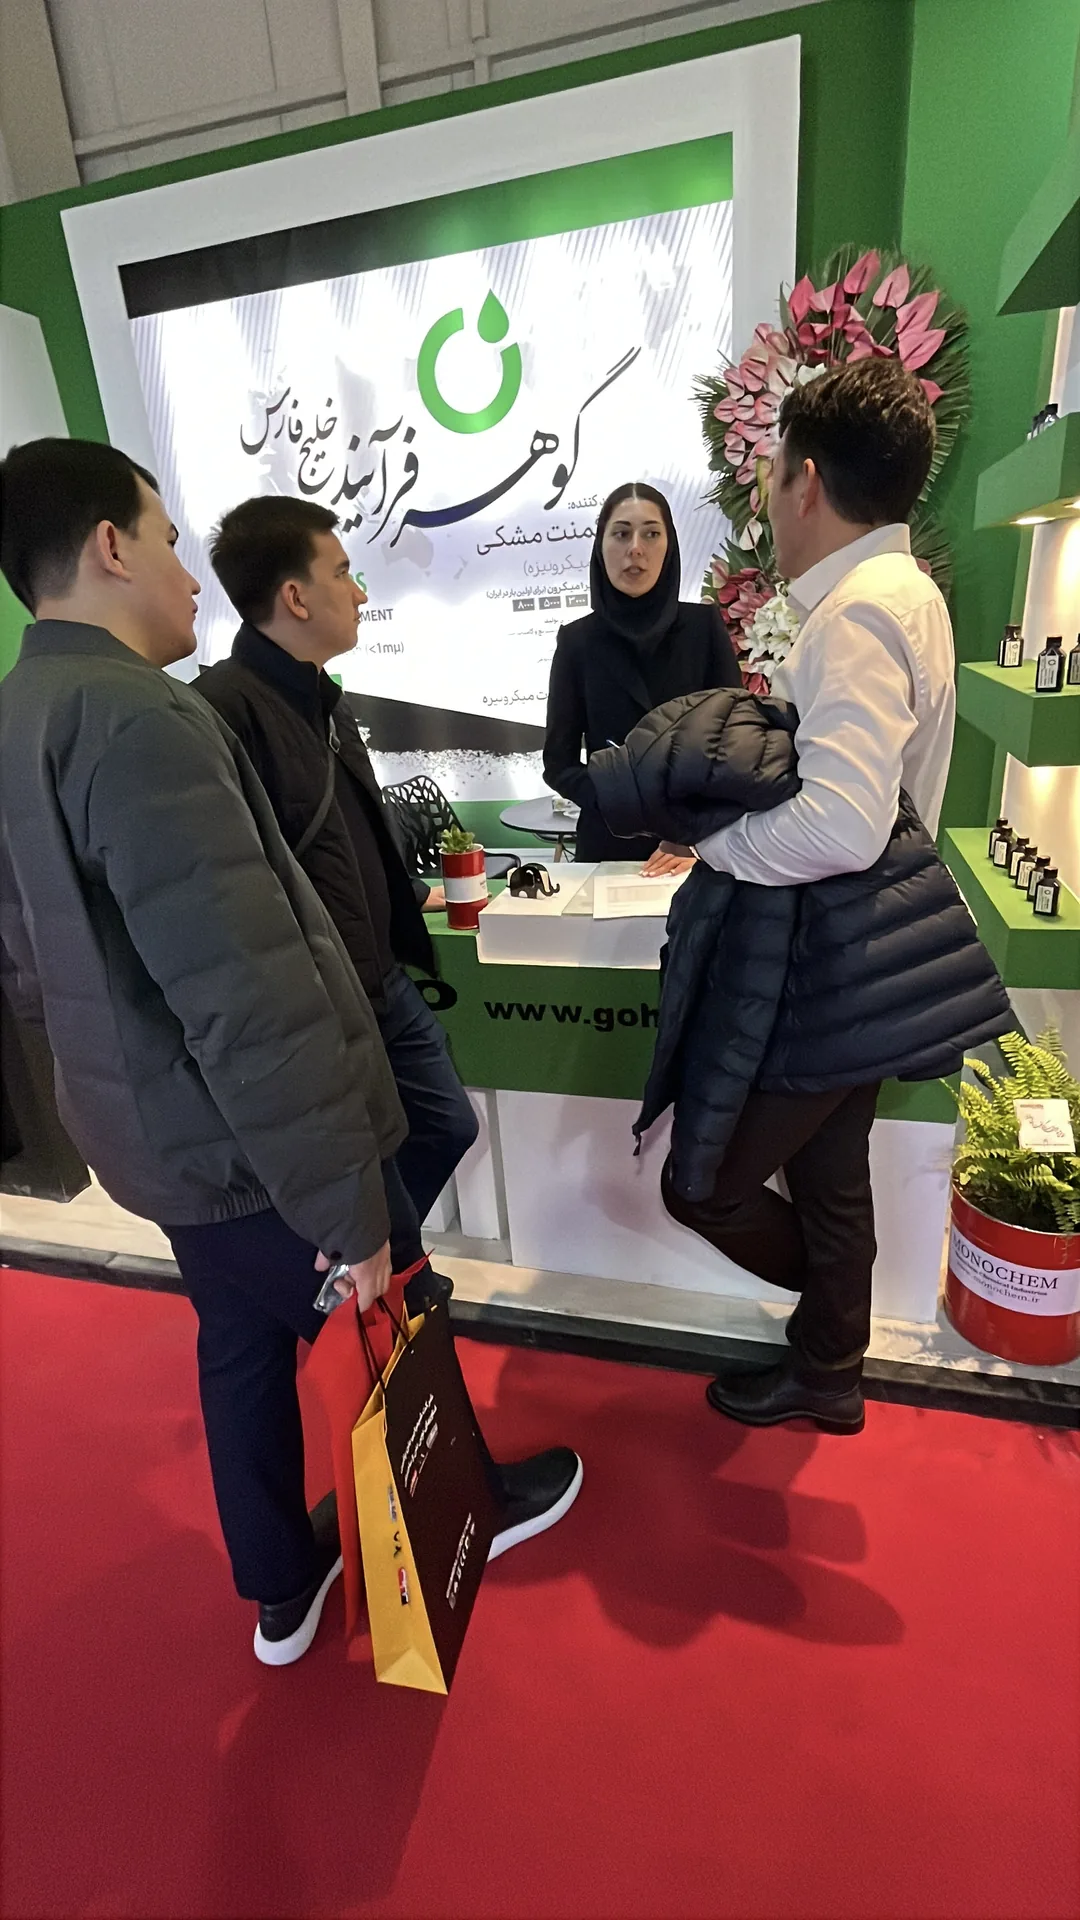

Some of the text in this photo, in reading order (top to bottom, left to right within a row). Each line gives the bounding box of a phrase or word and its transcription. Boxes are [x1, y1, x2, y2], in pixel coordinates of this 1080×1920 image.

[240, 387, 303, 455] فارس
[298, 397, 337, 495] خلیج
[390, 346, 641, 547] گوهر
[476, 524, 542, 556] مشکی
[547, 581, 580, 594] میکرون
[360, 608, 393, 622] MENT
[484, 1001, 659, 1032] www.goh
[953, 1233, 1059, 1289] MONOCHEM
